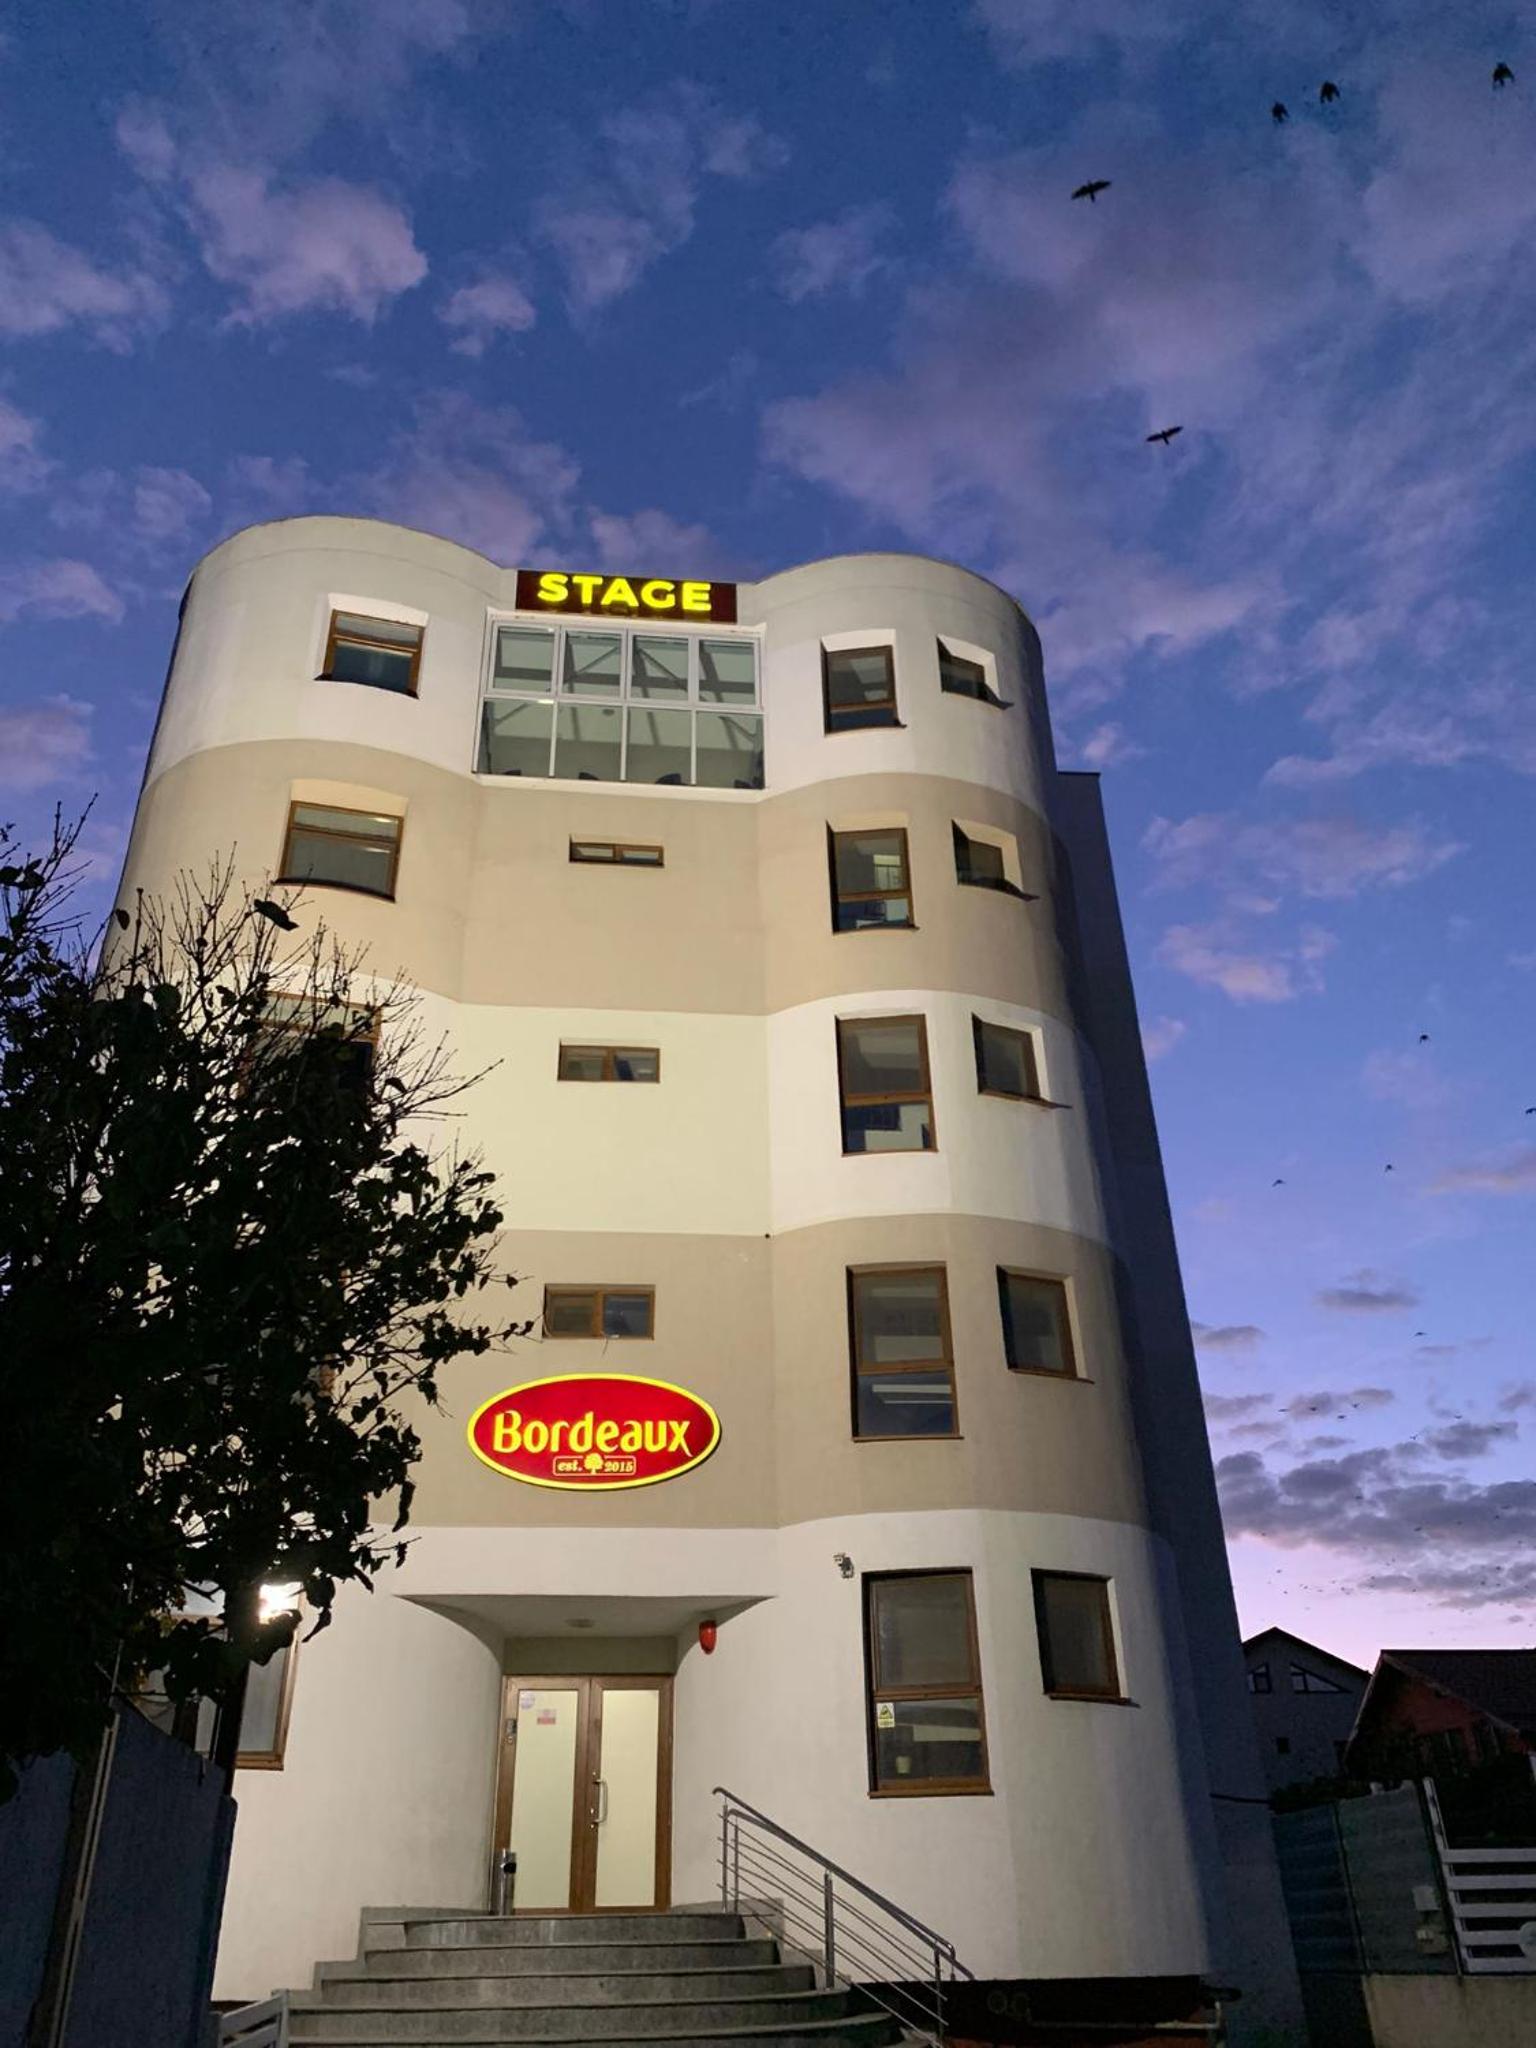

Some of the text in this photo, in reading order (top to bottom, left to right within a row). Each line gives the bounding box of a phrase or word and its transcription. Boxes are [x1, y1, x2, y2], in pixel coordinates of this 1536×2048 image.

[537, 573, 712, 612] STAGE
[493, 1410, 693, 1457] Bordeaux
[557, 1459, 634, 1473] est. 2015
